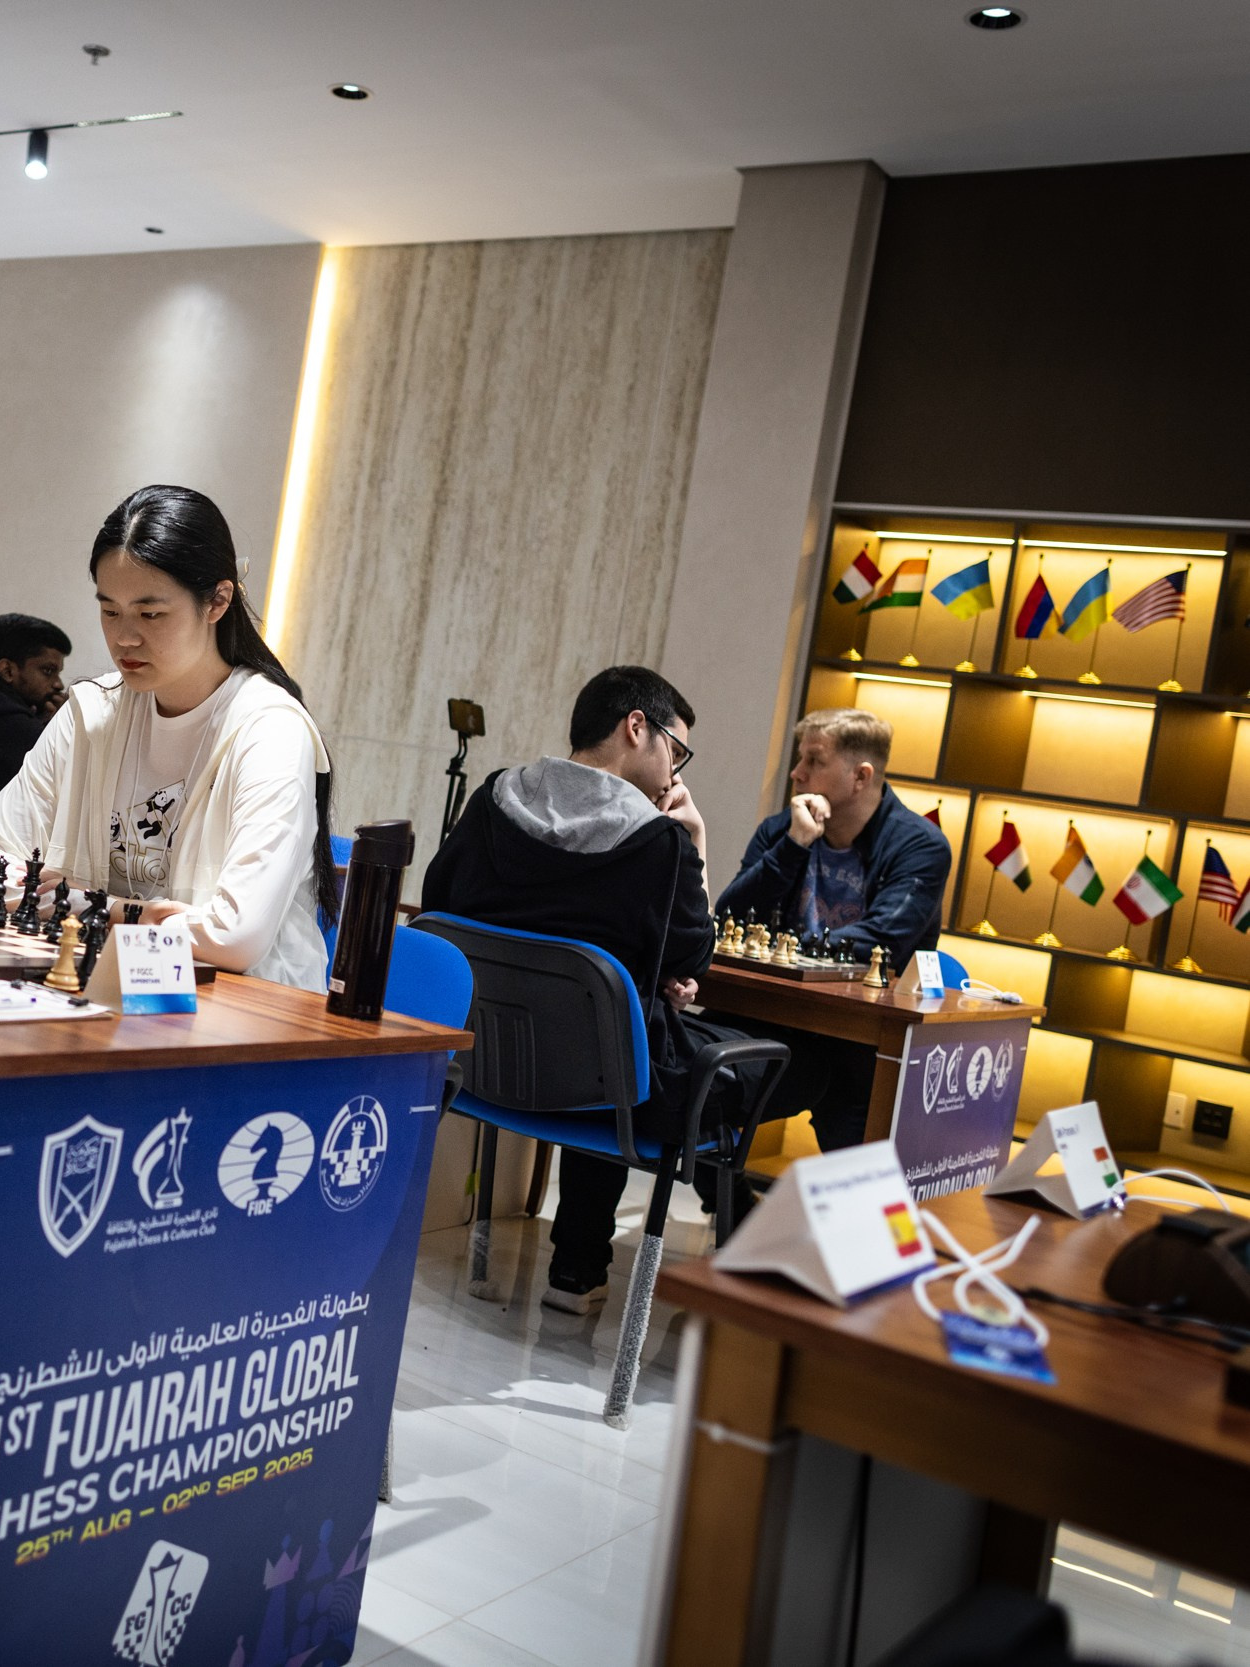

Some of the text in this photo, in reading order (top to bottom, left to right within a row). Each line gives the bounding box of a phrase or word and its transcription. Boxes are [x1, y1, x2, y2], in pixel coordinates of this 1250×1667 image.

[173, 965, 182, 981] 7
[247, 1197, 275, 1217] FIDE
[104, 1223, 217, 1254] Fujairah Chess & Culture Club
[250, 1300, 316, 1340] الفجيرة
[318, 1292, 370, 1320] بطولة
[105, 1332, 166, 1378] الأولى
[170, 1316, 248, 1361] العالمية
[43, 1356, 237, 1478] FUJAIRAH
[239, 1325, 360, 1420] GLOBAL
[108, 1396, 354, 1501] CHAMPIONSHIP
[14, 1527, 73, 1567] 25TH
[79, 1508, 132, 1544] AUG
[162, 1481, 212, 1515] 02ND
[215, 1467, 258, 1497] SEP
[263, 1447, 314, 1482] 2025
[170, 1593, 192, 1616] CC
[124, 1611, 147, 1636] FG
